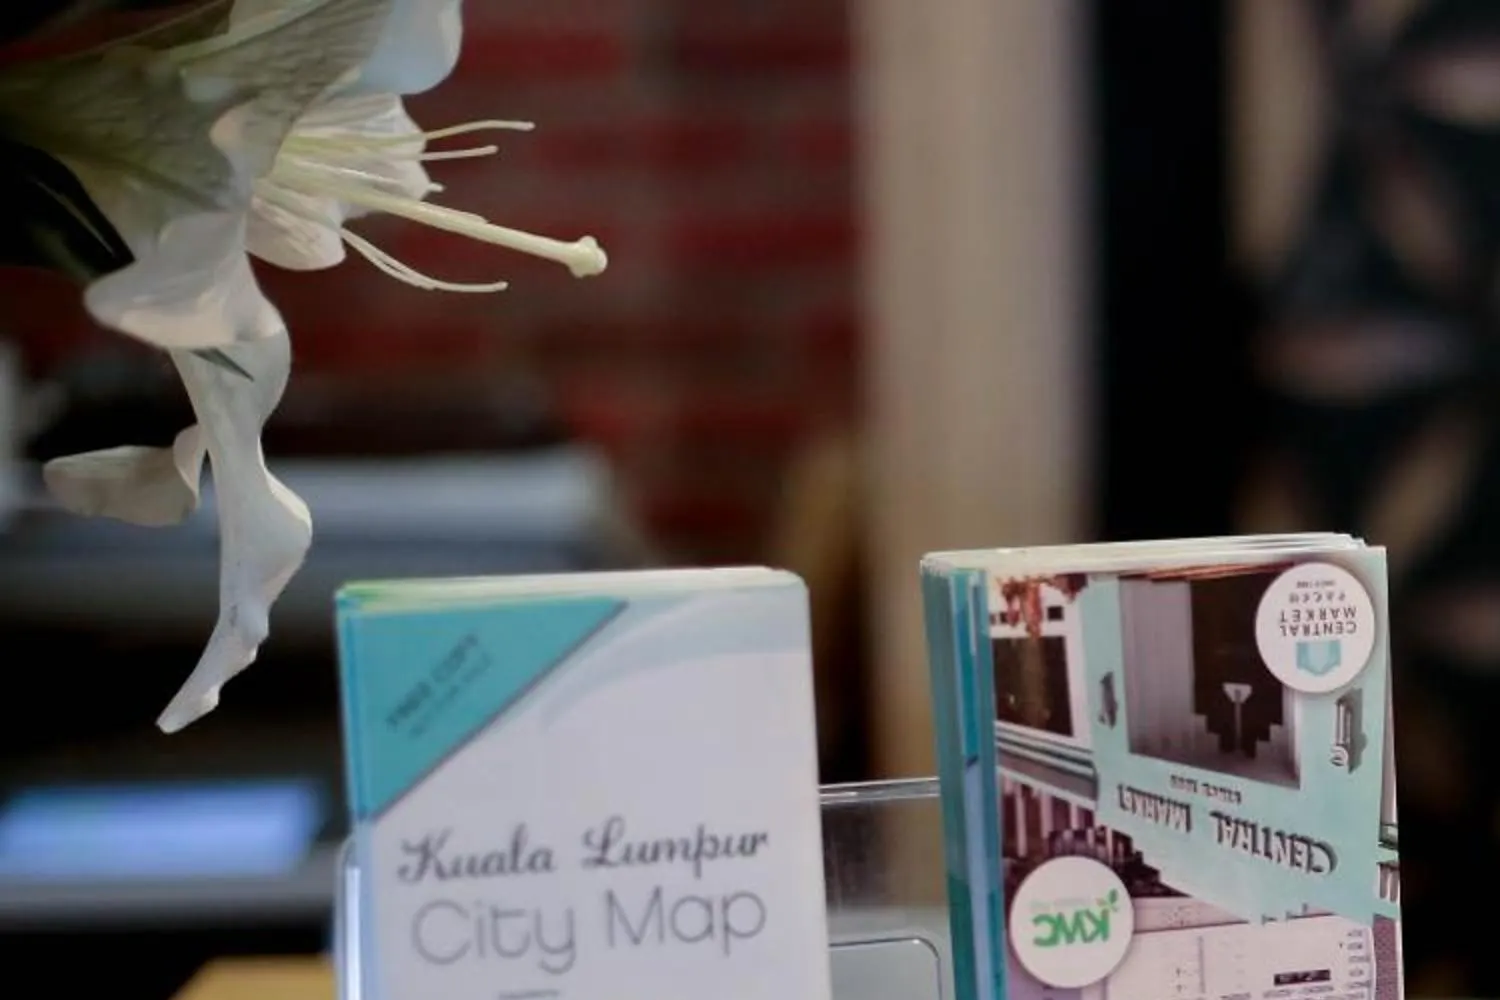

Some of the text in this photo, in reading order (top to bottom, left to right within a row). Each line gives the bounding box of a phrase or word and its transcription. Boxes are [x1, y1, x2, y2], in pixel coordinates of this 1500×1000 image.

[1279, 621, 1357, 637] CENTRAL
[1280, 606, 1357, 623] MARKET
[397, 816, 770, 884] Kuala Lumpur
[411, 886, 767, 975] City Map
[1032, 908, 1110, 948] KWC
